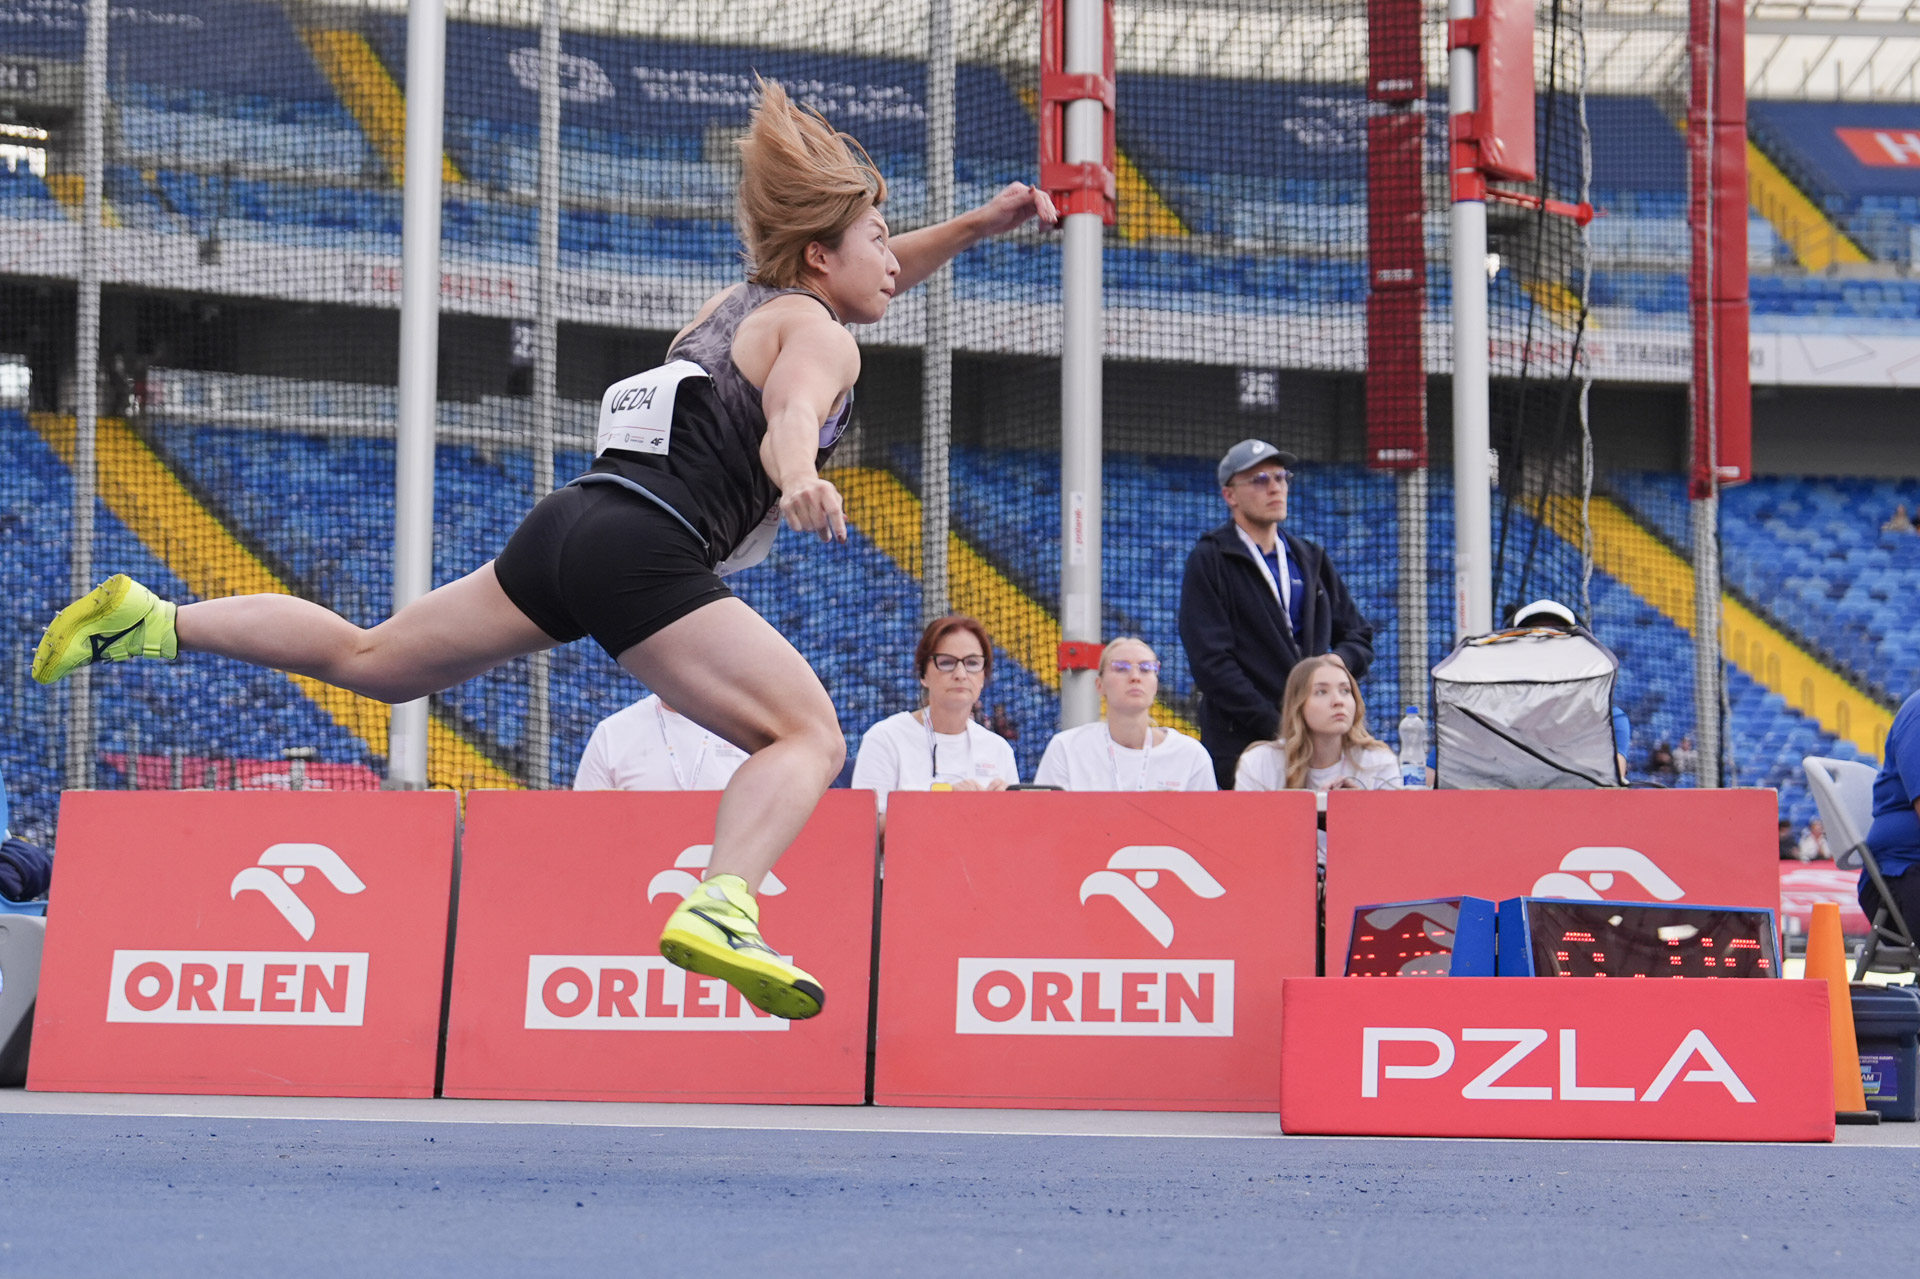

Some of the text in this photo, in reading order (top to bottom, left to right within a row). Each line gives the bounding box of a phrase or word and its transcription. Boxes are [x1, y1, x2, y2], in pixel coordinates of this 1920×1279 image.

[611, 386, 657, 414] UEDA
[125, 961, 349, 1013] ORLEN
[972, 970, 1215, 1022] ORLEN
[1361, 1027, 1757, 1103] PZLA
